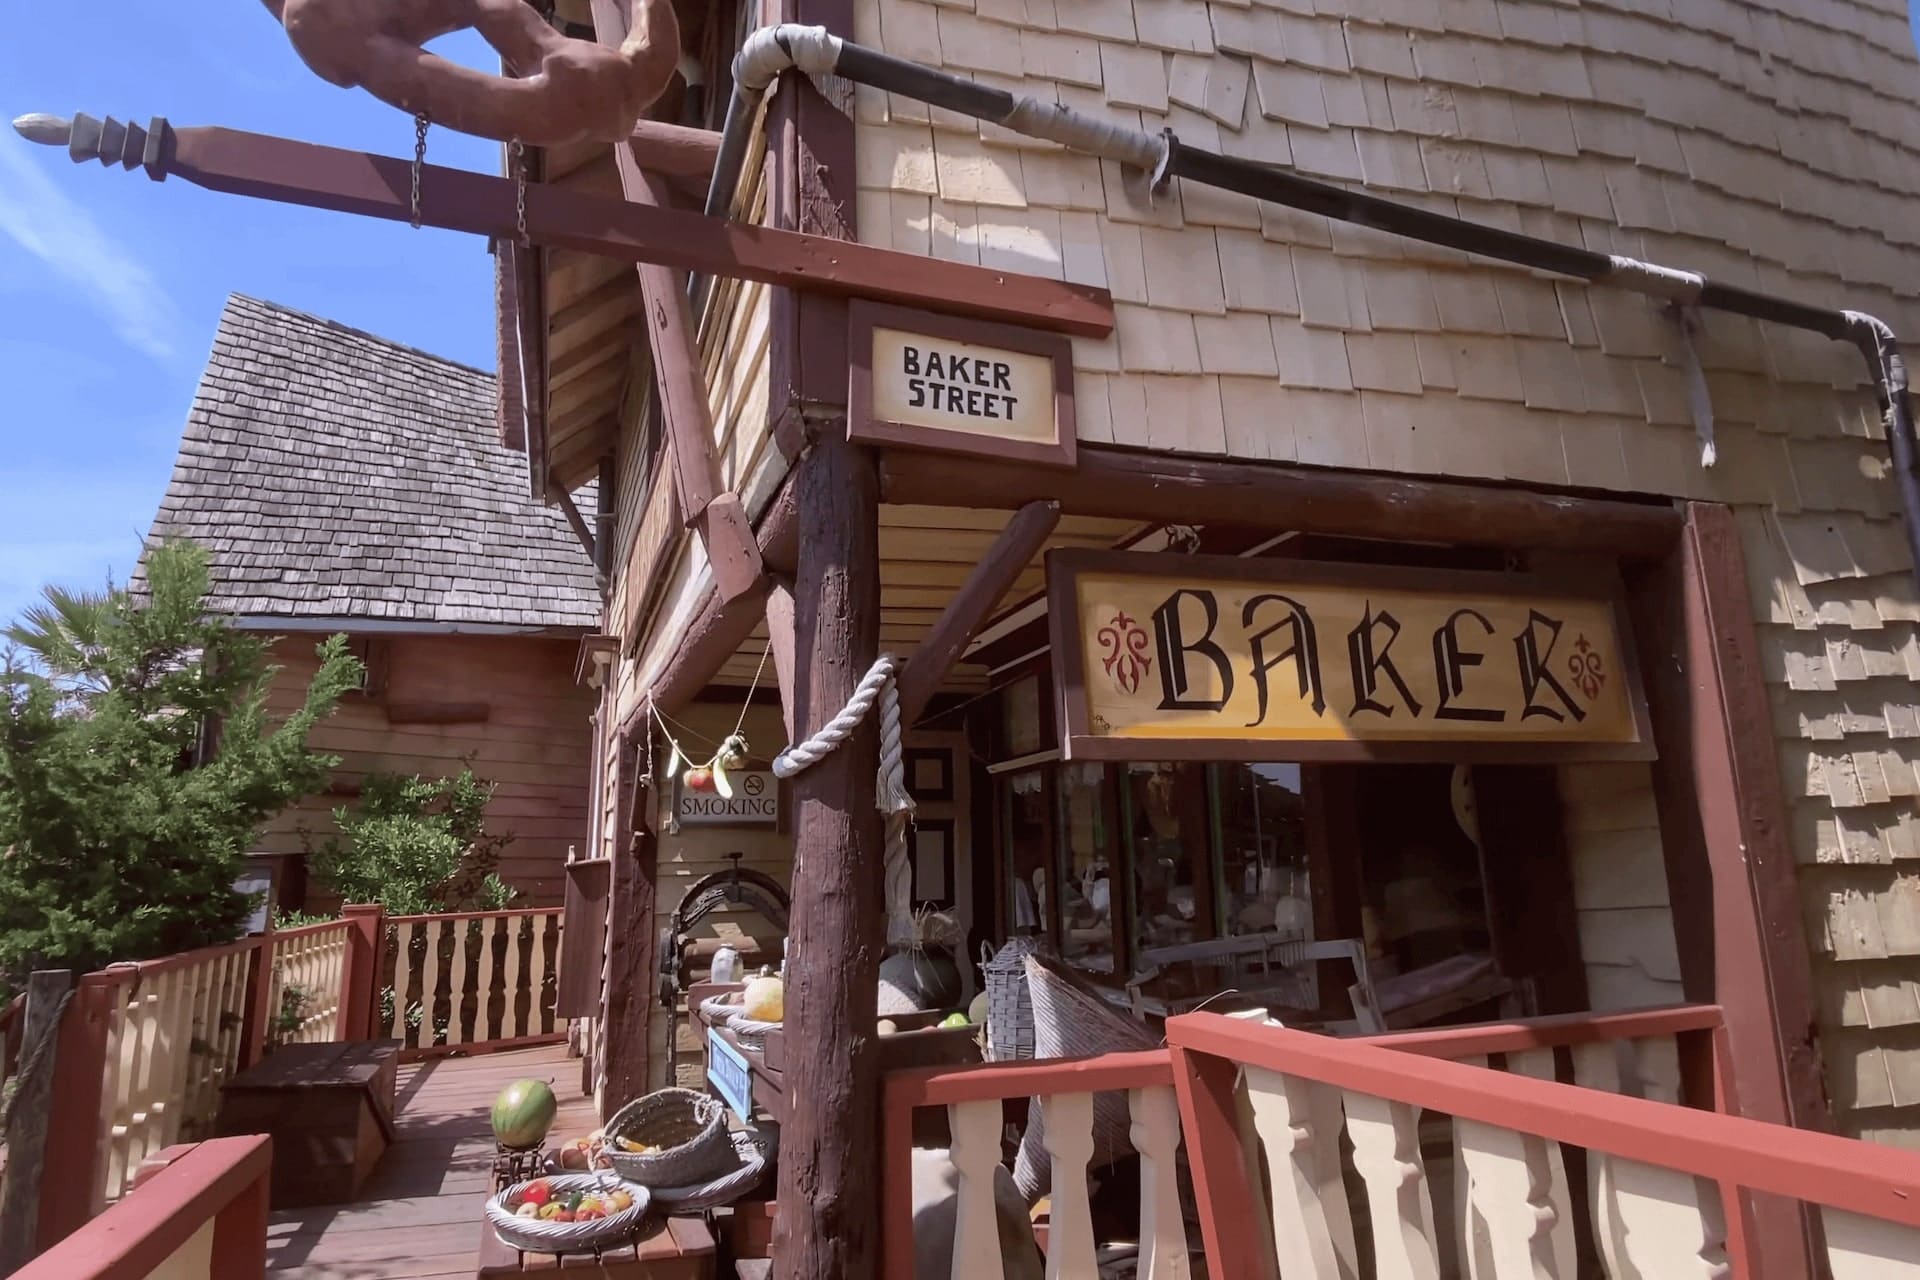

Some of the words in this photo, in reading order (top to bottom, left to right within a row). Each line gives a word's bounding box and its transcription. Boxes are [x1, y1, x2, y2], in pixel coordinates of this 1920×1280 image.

[903, 346, 1012, 391] BAKER
[908, 378, 1018, 421] STREET
[1150, 588, 1586, 728] BAKER
[681, 797, 776, 816] SMOKING
